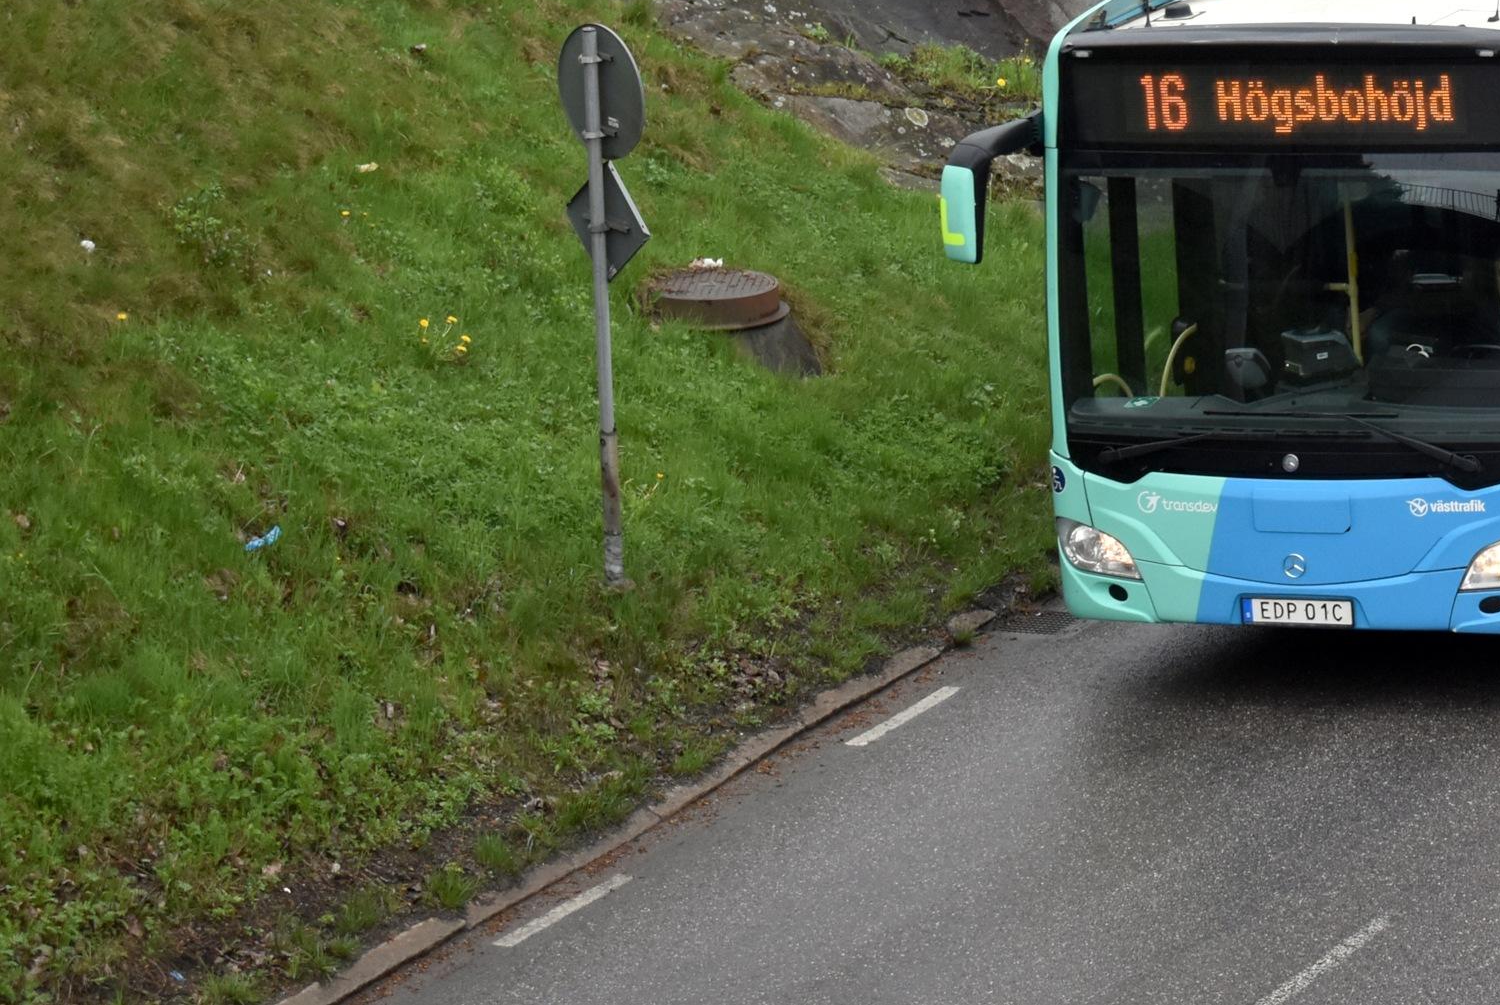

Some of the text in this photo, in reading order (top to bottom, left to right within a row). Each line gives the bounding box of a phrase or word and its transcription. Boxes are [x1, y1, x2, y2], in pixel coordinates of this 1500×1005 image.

[1140, 74, 1455, 133] 16 Högsbohöjd
[1162, 498, 1218, 513] transdev
[1430, 499, 1486, 513] västtrafik
[1260, 601, 1344, 621] EDP 01C
